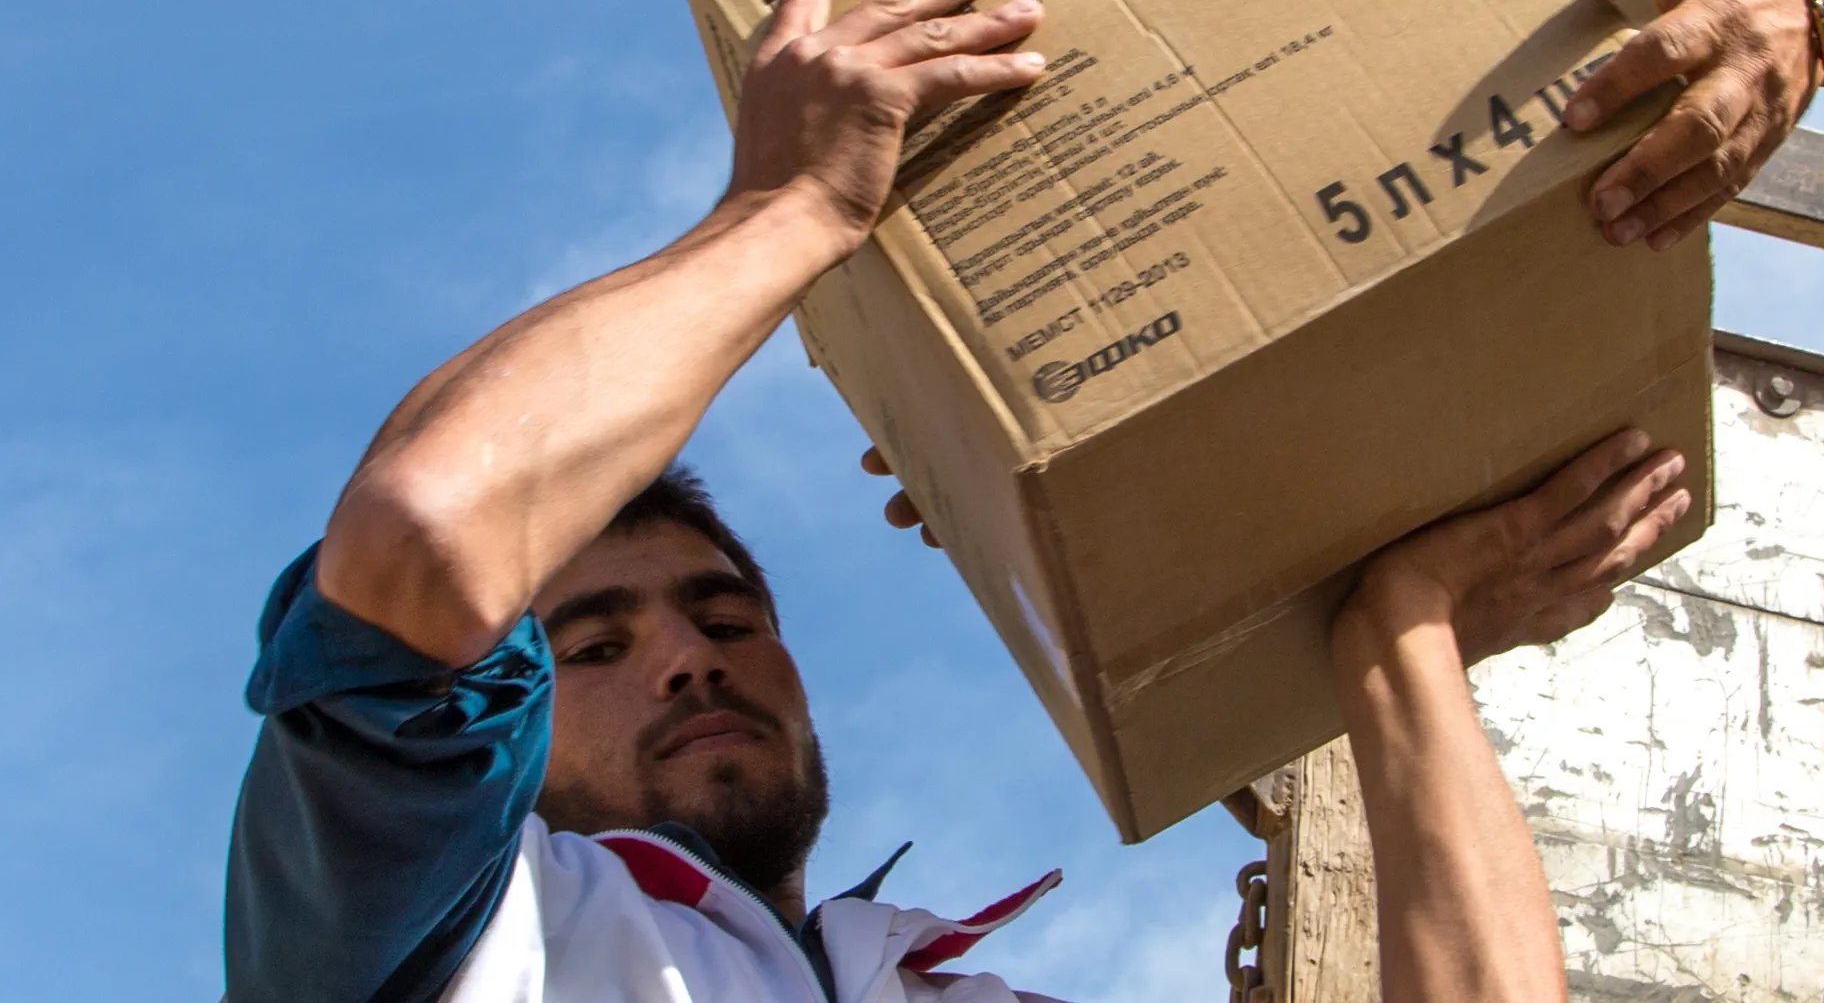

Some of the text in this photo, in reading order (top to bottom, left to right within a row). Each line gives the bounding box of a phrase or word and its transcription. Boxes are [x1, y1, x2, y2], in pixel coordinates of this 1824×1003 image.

[1080, 102, 1092, 114] 5
[1116, 163, 1137, 179] 12
[1315, 180, 1373, 245] 5
[1376, 162, 1435, 220] л
[1487, 93, 1537, 149] 4
[1088, 252, 1191, 314] 1129-2013
